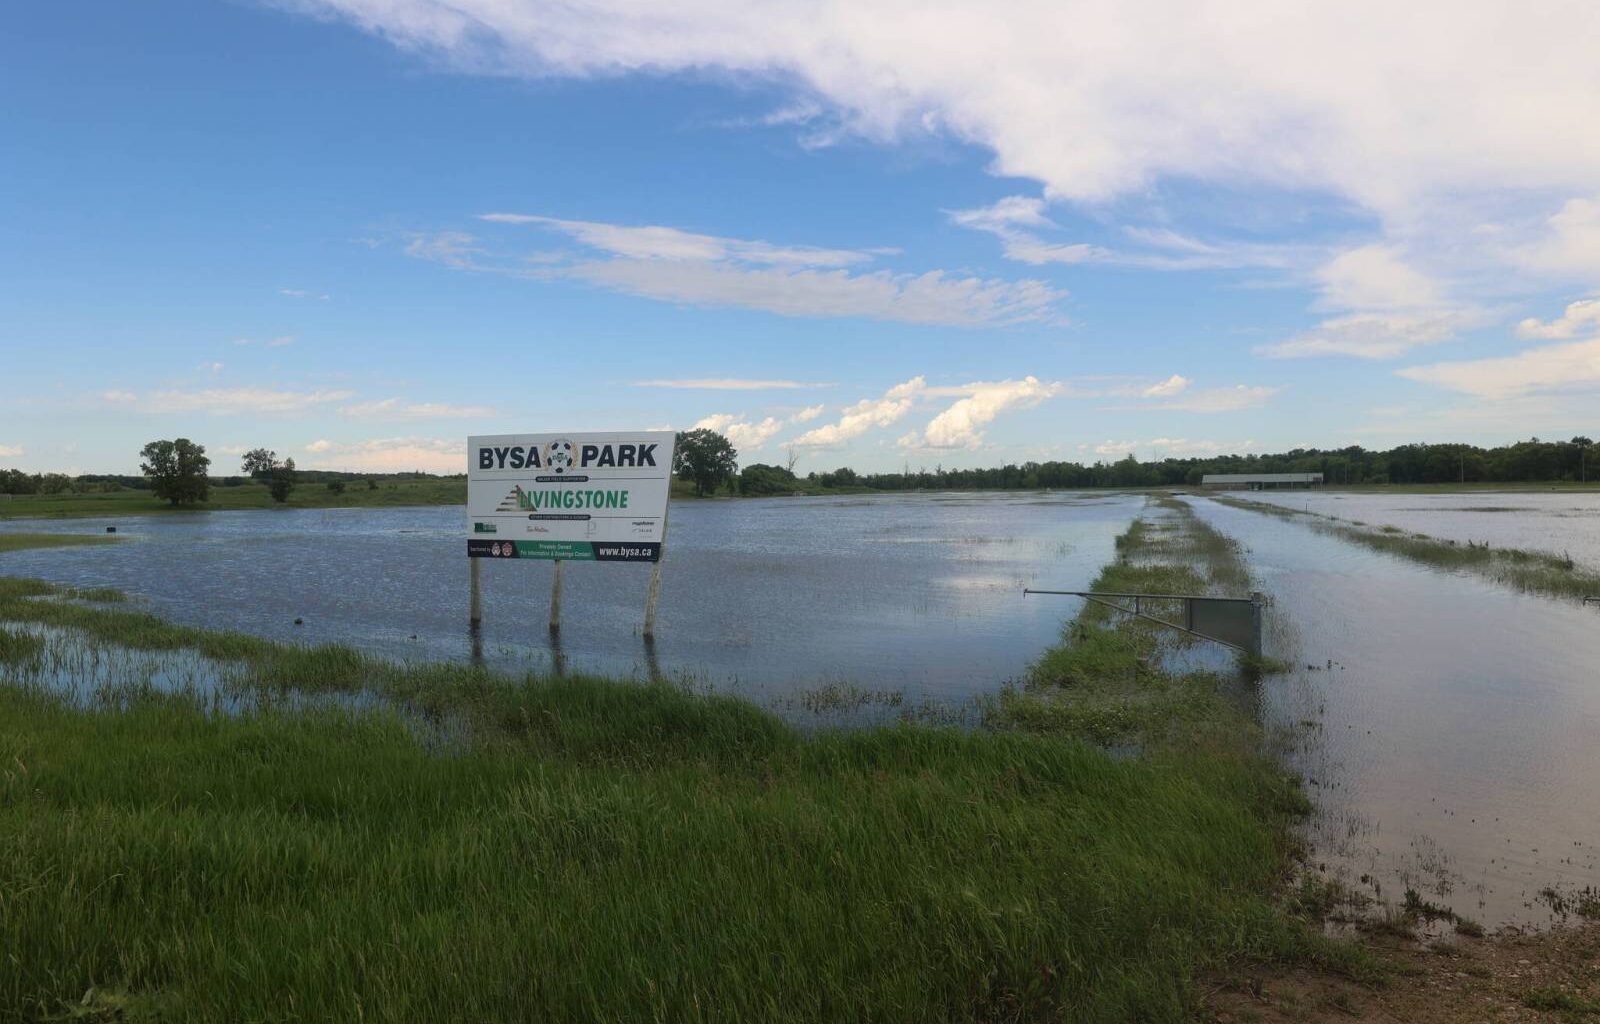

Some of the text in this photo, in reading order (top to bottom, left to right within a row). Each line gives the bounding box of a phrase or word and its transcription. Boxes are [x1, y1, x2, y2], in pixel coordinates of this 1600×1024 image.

[479, 444, 658, 470] BYSA PARK
[520, 490, 629, 509] LIVINGSTONE
[599, 546, 652, 558] www.bysa.ca
